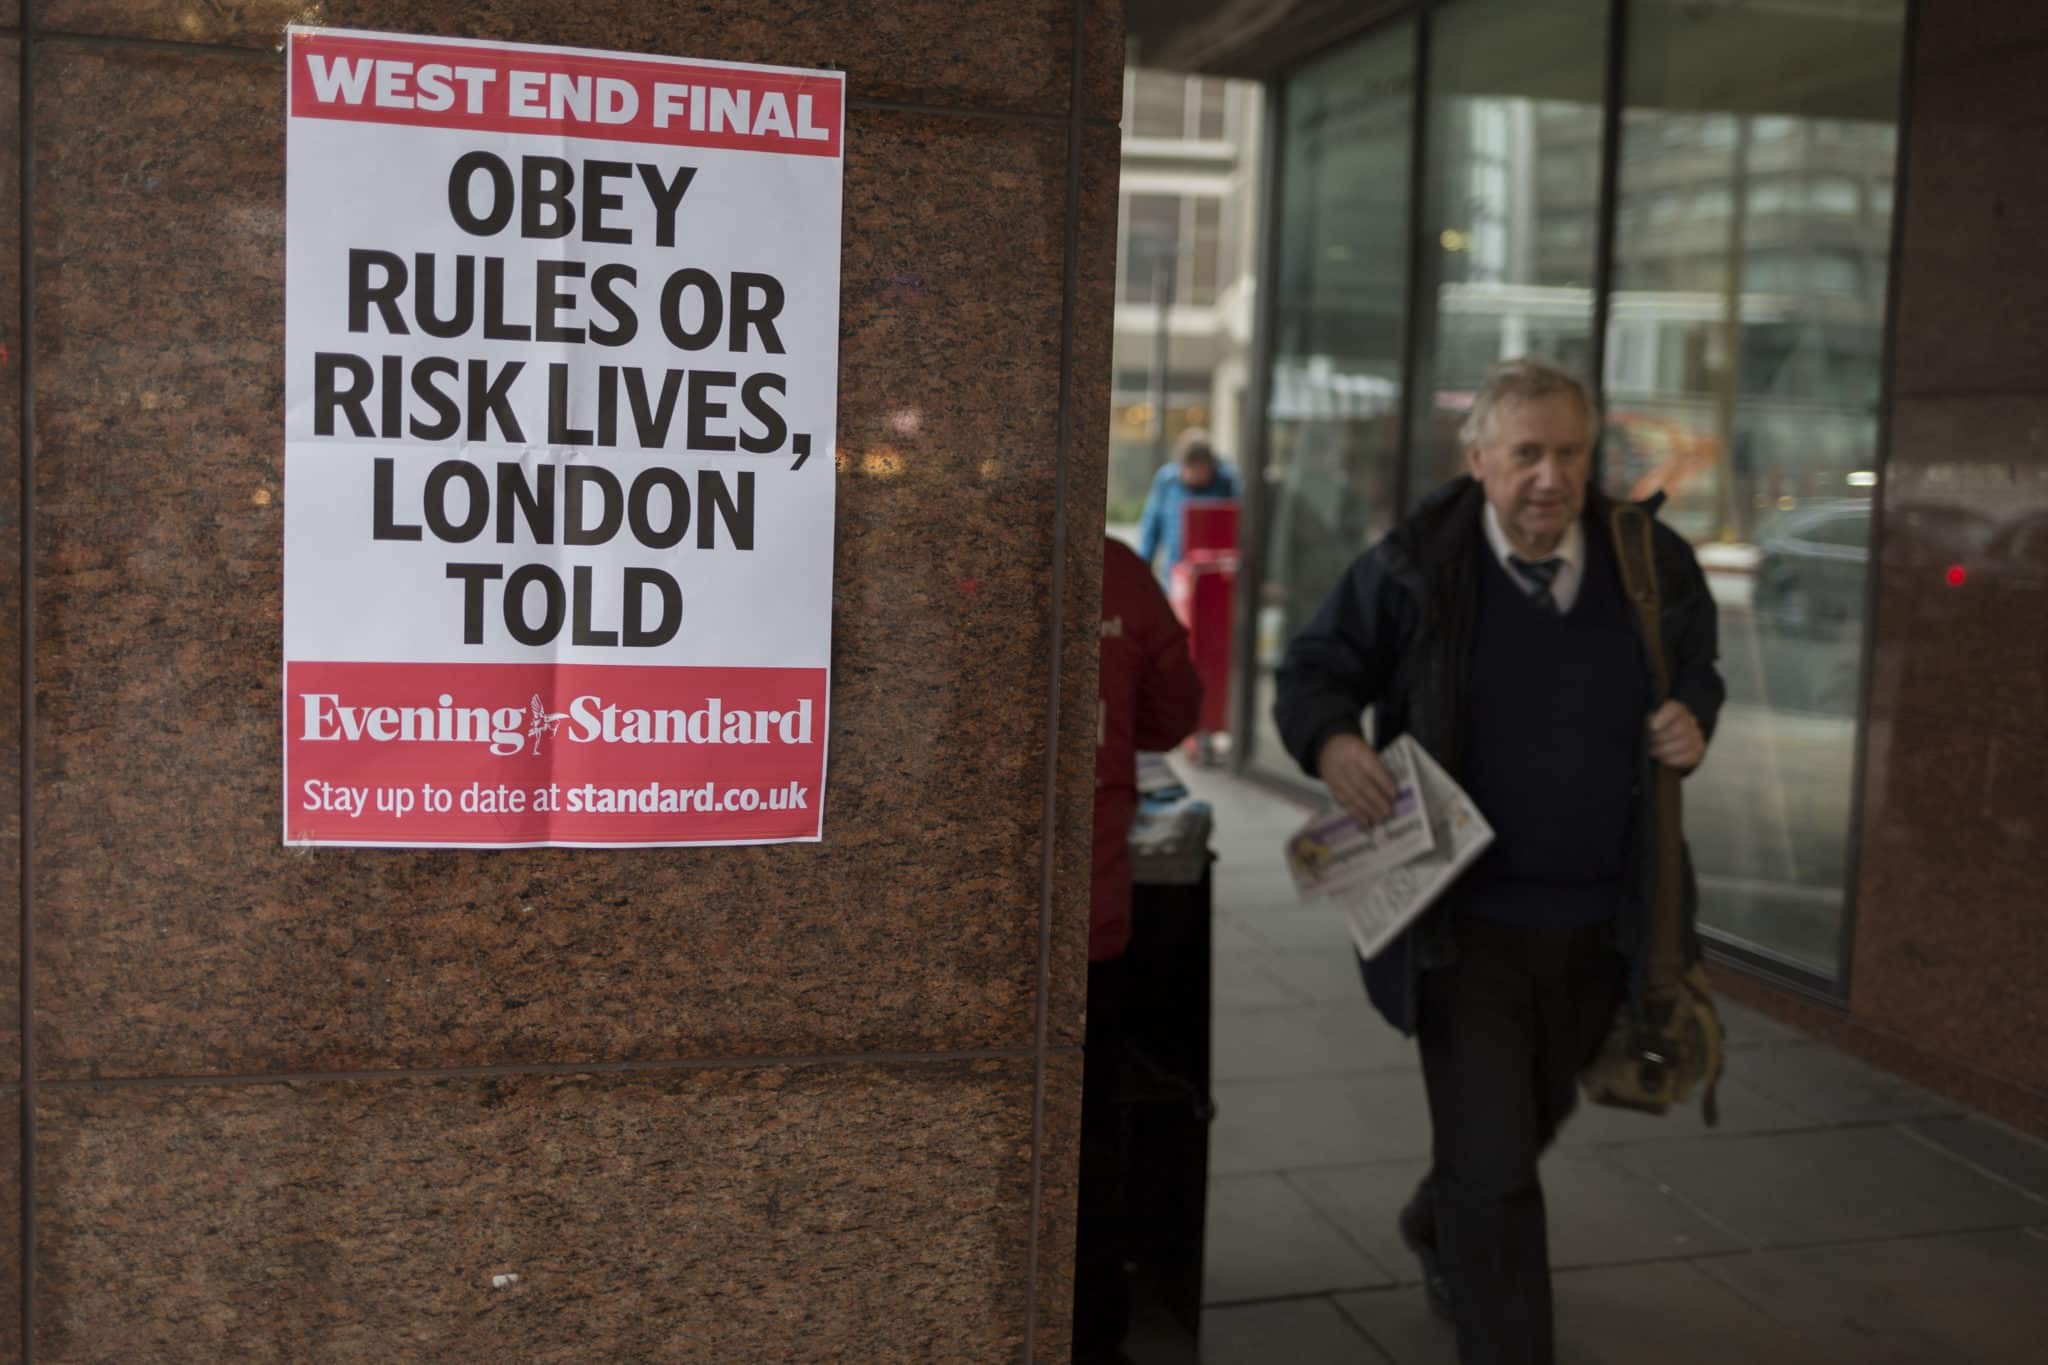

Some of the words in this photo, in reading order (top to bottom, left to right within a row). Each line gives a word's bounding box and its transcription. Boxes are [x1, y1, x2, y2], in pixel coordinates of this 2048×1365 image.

[306, 54, 497, 115] WEST
[508, 70, 640, 126] END
[652, 82, 830, 142] FINAL
[447, 150, 699, 248] OBEY
[347, 247, 639, 348] RULES
[659, 266, 787, 355] OR
[313, 351, 527, 444] RISK
[547, 361, 813, 472] LIVES,
[372, 456, 756, 552] LONDON
[445, 561, 684, 649] TOLD
[298, 692, 528, 757] Evening
[566, 694, 814, 746] Standard
[303, 777, 369, 818] Stay
[376, 785, 415, 819] up
[421, 782, 453, 813] to
[459, 780, 526, 814] date
[532, 782, 562, 813] at
[565, 779, 809, 814] standard.co.uk
